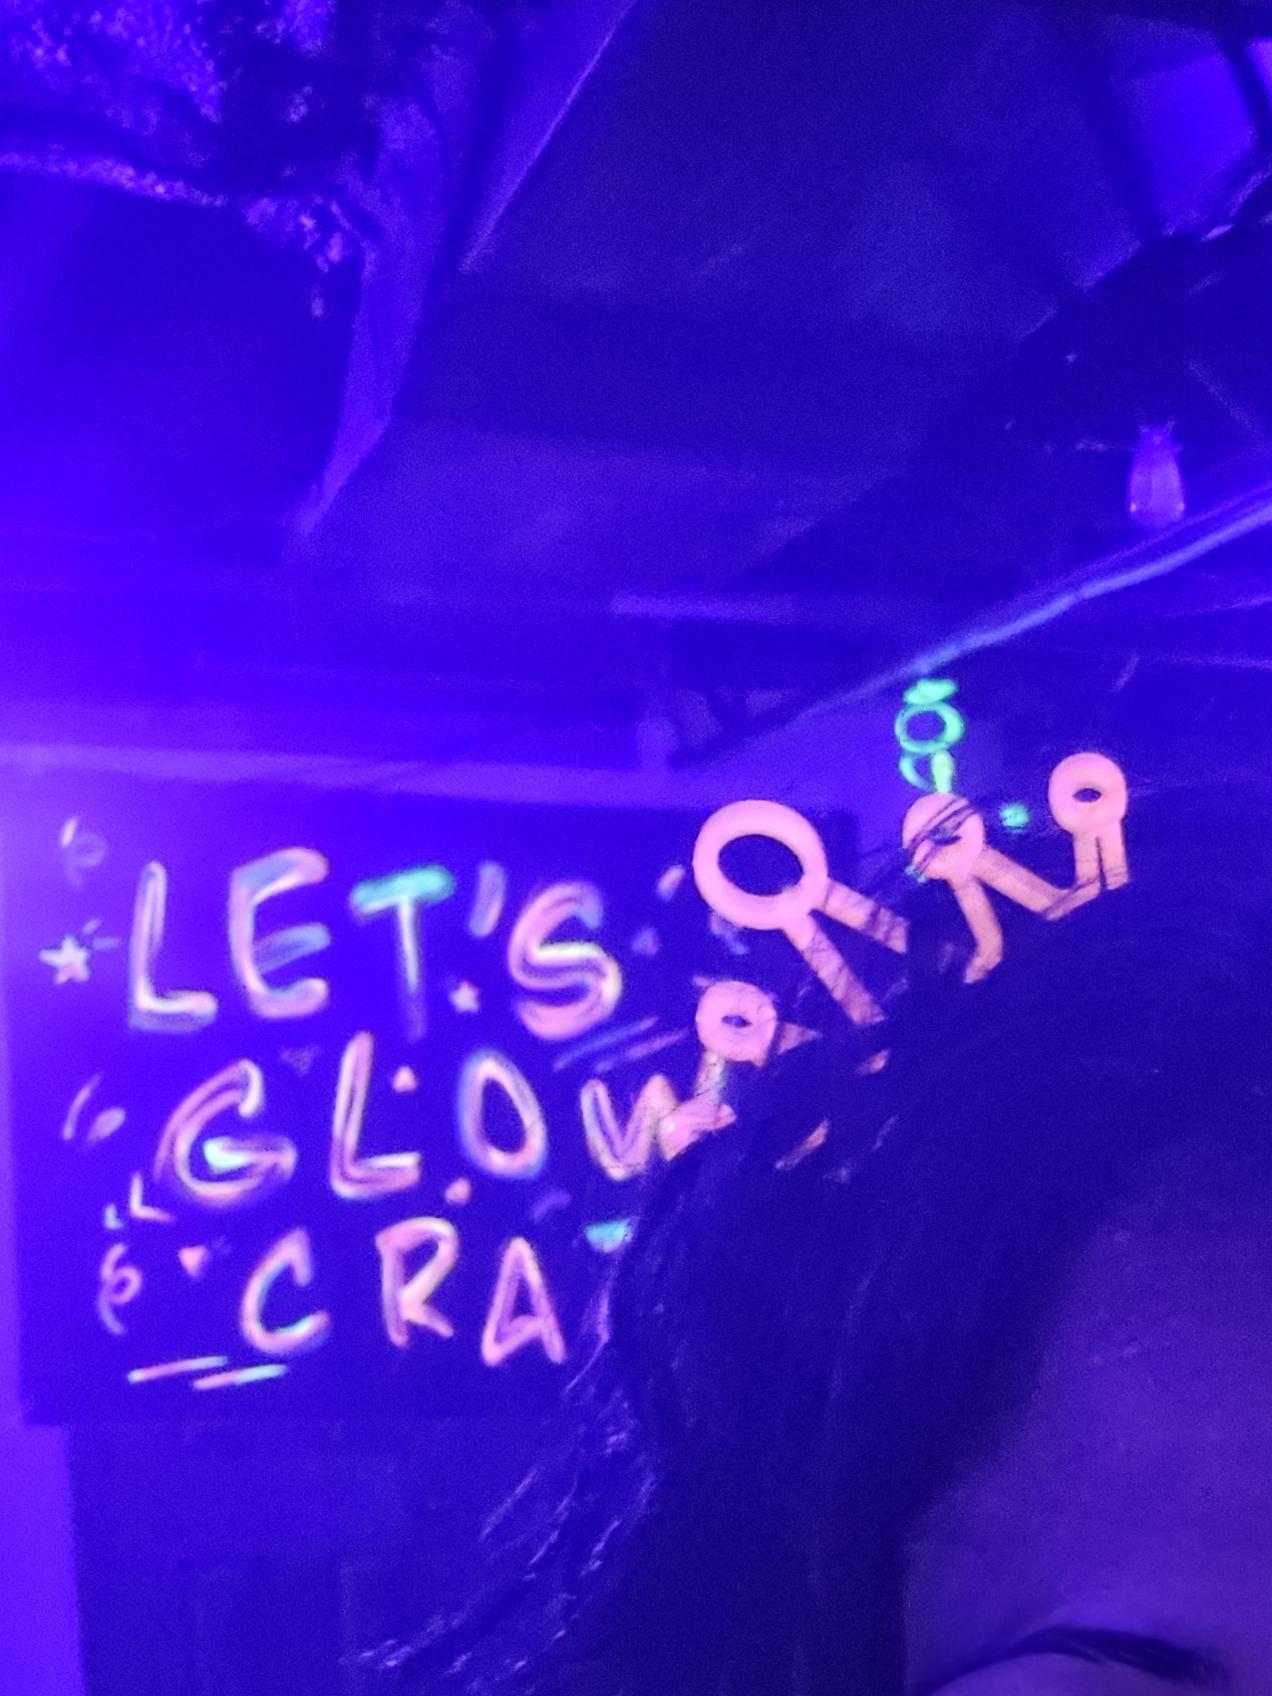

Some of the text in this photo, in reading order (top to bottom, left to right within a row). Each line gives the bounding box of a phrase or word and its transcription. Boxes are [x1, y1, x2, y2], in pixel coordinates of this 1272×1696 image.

[128, 848, 623, 1040] LET'S
[154, 1032, 690, 1206] GLOW
[240, 1214, 638, 1367] CRA
